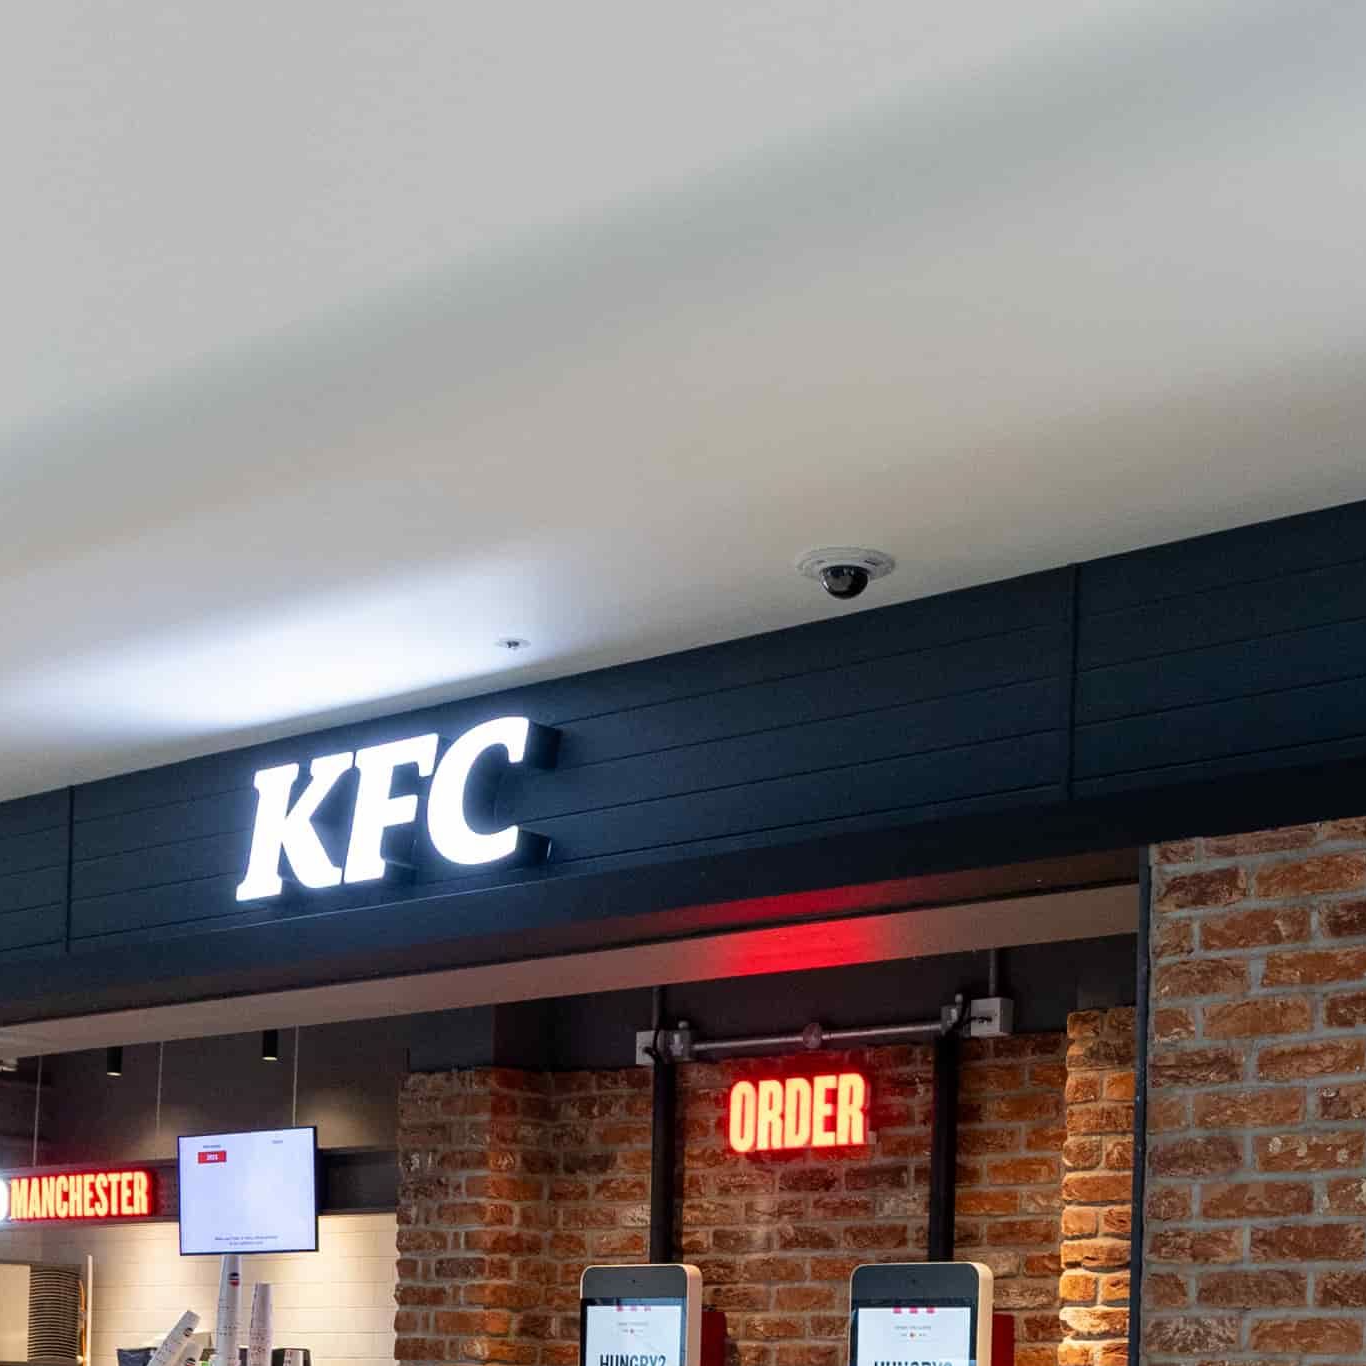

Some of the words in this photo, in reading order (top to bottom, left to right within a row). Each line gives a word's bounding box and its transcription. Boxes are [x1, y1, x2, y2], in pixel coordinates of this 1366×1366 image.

[236, 716, 530, 901] KFC
[729, 1072, 866, 1152] ORDER
[10, 1170, 150, 1220] MANCHESTER
